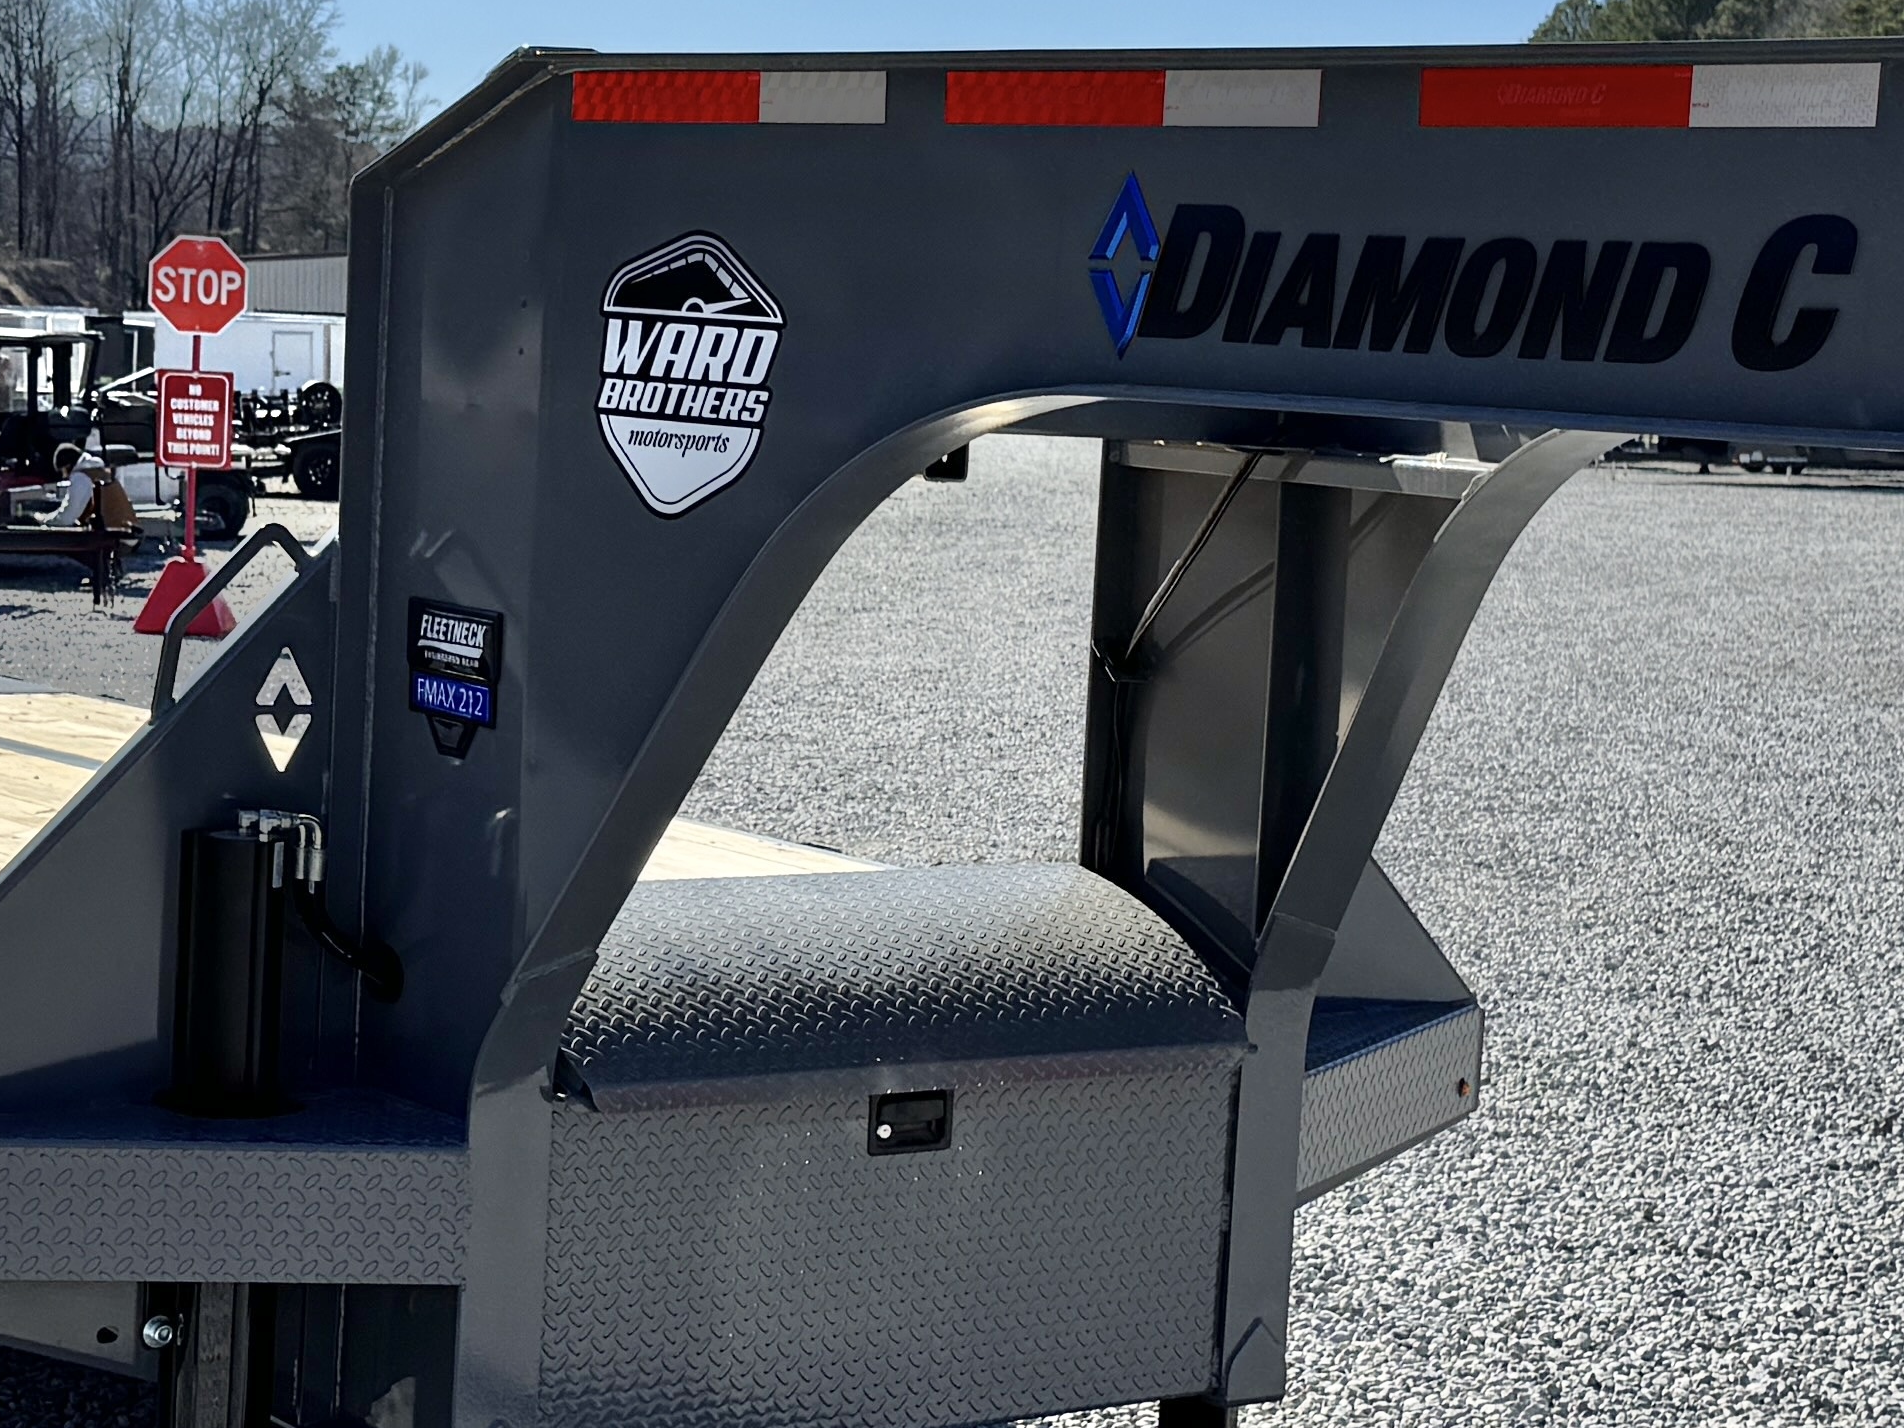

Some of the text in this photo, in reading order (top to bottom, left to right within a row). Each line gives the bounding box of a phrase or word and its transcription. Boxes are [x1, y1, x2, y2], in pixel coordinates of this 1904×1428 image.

[155, 266, 242, 305] STOP
[1732, 214, 1859, 372] C
[602, 317, 779, 385] WARD
[170, 398, 220, 412] CUSTOMER
[598, 378, 769, 423] BROTHERS
[172, 412, 214, 427] VEHICLES
[176, 427, 212, 441] BEYOND
[627, 427, 730, 457] motorsports
[420, 614, 487, 648] FLEETNECK
[418, 678, 483, 716] FMAX 212
